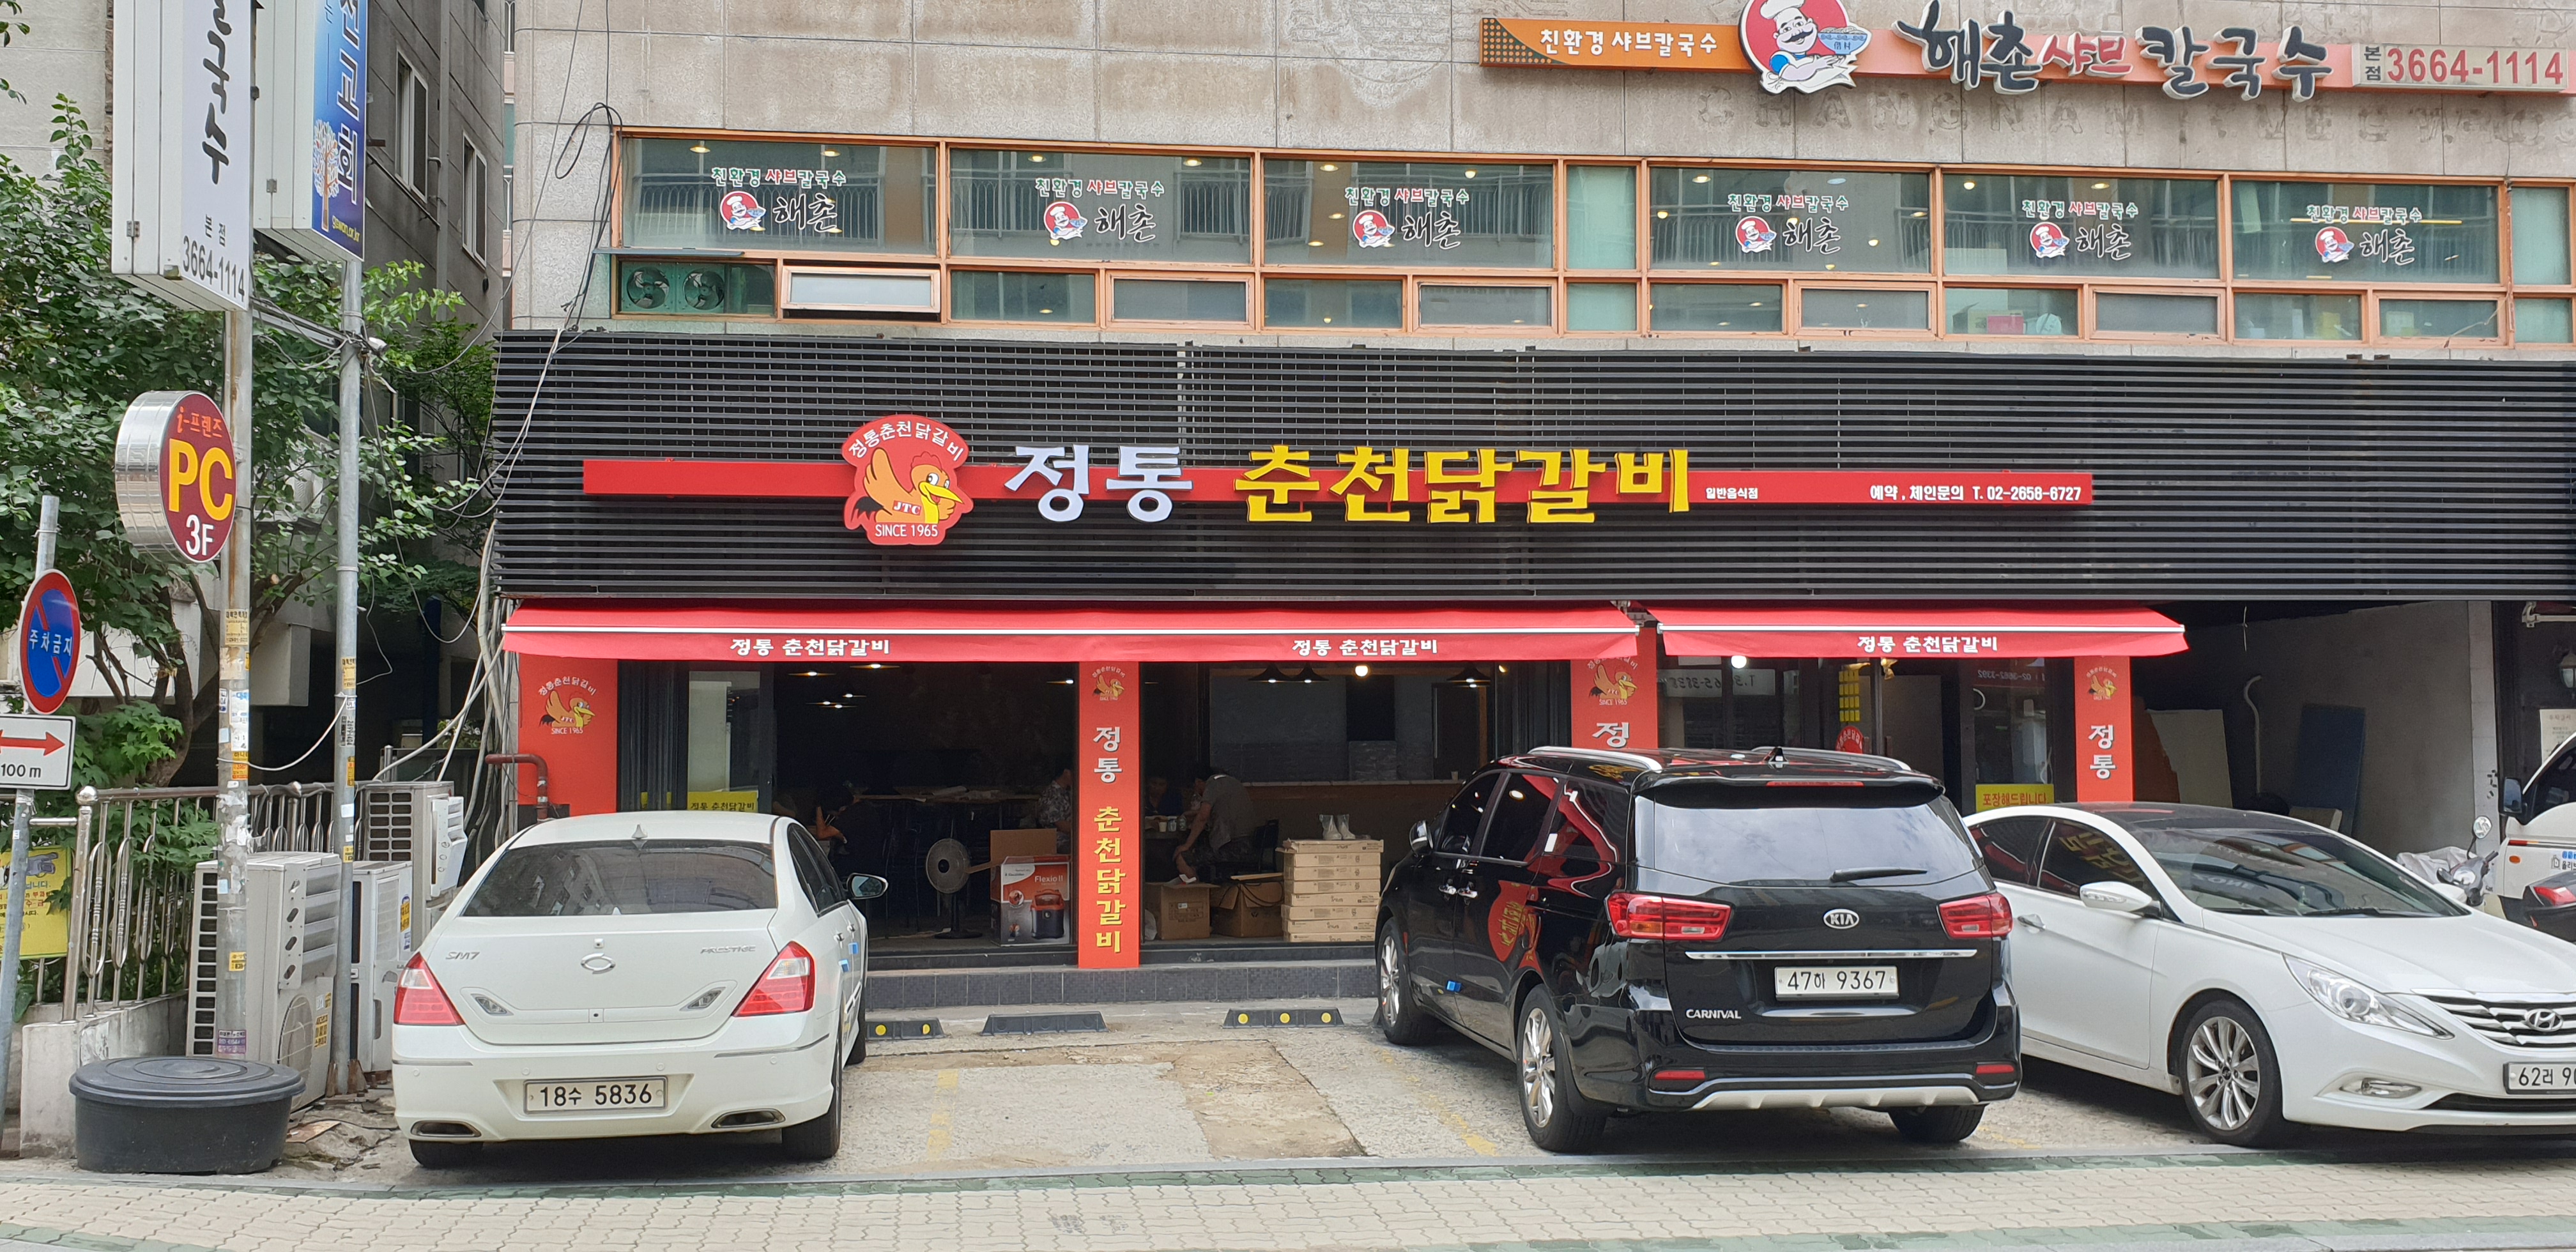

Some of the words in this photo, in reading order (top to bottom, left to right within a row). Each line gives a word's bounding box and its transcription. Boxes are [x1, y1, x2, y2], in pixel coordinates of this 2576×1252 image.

[1540, 29, 1604, 56] 친환경
[1612, 30, 1717, 58] 샤브칼국수
[1892, 0, 2043, 95] 해촌
[2388, 48, 2563, 84] 3664-1114
[203, 0, 231, 185] 국수
[711, 167, 761, 187] 친환경
[765, 168, 847, 188] 샤브칼국수
[1035, 178, 1083, 198] 친환경
[1087, 179, 1165, 199] 샤브칼국수
[1344, 187, 1391, 206] 친환경
[1395, 188, 1469, 207] 샤브칼국수
[1728, 194, 1772, 212] 친환경
[1775, 194, 1849, 213] 샤브칼국수
[772, 193, 838, 233] 해촌
[2022, 200, 2065, 218] 친환경
[2068, 201, 2138, 220] 샤브칼국수
[2306, 204, 2349, 222] 친환경
[2352, 206, 2422, 225] 샤브칼국수
[1094, 203, 1156, 243] 해촌
[1401, 211, 1461, 250] 해촌
[1782, 217, 1841, 254] 해촌
[2074, 224, 2131, 261] 해촌
[2360, 228, 2414, 265] 해촌
[183, 235, 245, 302] 3664-1114
[177, 406, 223, 438] i-프렌즈
[169, 438, 233, 521] PC
[1004, 445, 1193, 523] 정통
[1233, 445, 1690, 523] 춘천닭갈비
[1705, 487, 1758, 500] 일반음식점
[1870, 486, 1897, 500] 예약
[1910, 486, 1964, 501] 체인문의
[1986, 486, 2082, 501] 02-2658-6727
[894, 501, 921, 514] JTC
[186, 514, 214, 556] 3F
[875, 524, 907, 537] SINCE
[911, 524, 939, 537] 1965
[29, 629, 72, 656] 주차금지
[730, 638, 774, 656] 정통
[782, 639, 889, 657] 춘천닭갈비
[1292, 639, 1332, 656] 정통
[1339, 639, 1438, 656] 춘천닭갈비
[1857, 636, 1896, 653] 정통
[1903, 636, 1998, 653] 춘천닭갈비
[1093, 726, 1123, 783] 정통
[2089, 724, 2116, 779] 정통
[2, 764, 26, 777] 100
[1094, 806, 1126, 953] 춘천닭갈비
[1830, 913, 1854, 925] KIA
[445, 951, 480, 960] SM7
[1788, 972, 1825, 991] 47하
[1837, 970, 1885, 989] 9367
[1686, 1009, 1742, 1019] CARNIVAL
[2562, 1067, 2576, 1086] 9
[540, 1086, 582, 1107] 18수
[595, 1083, 652, 1106] 5836
